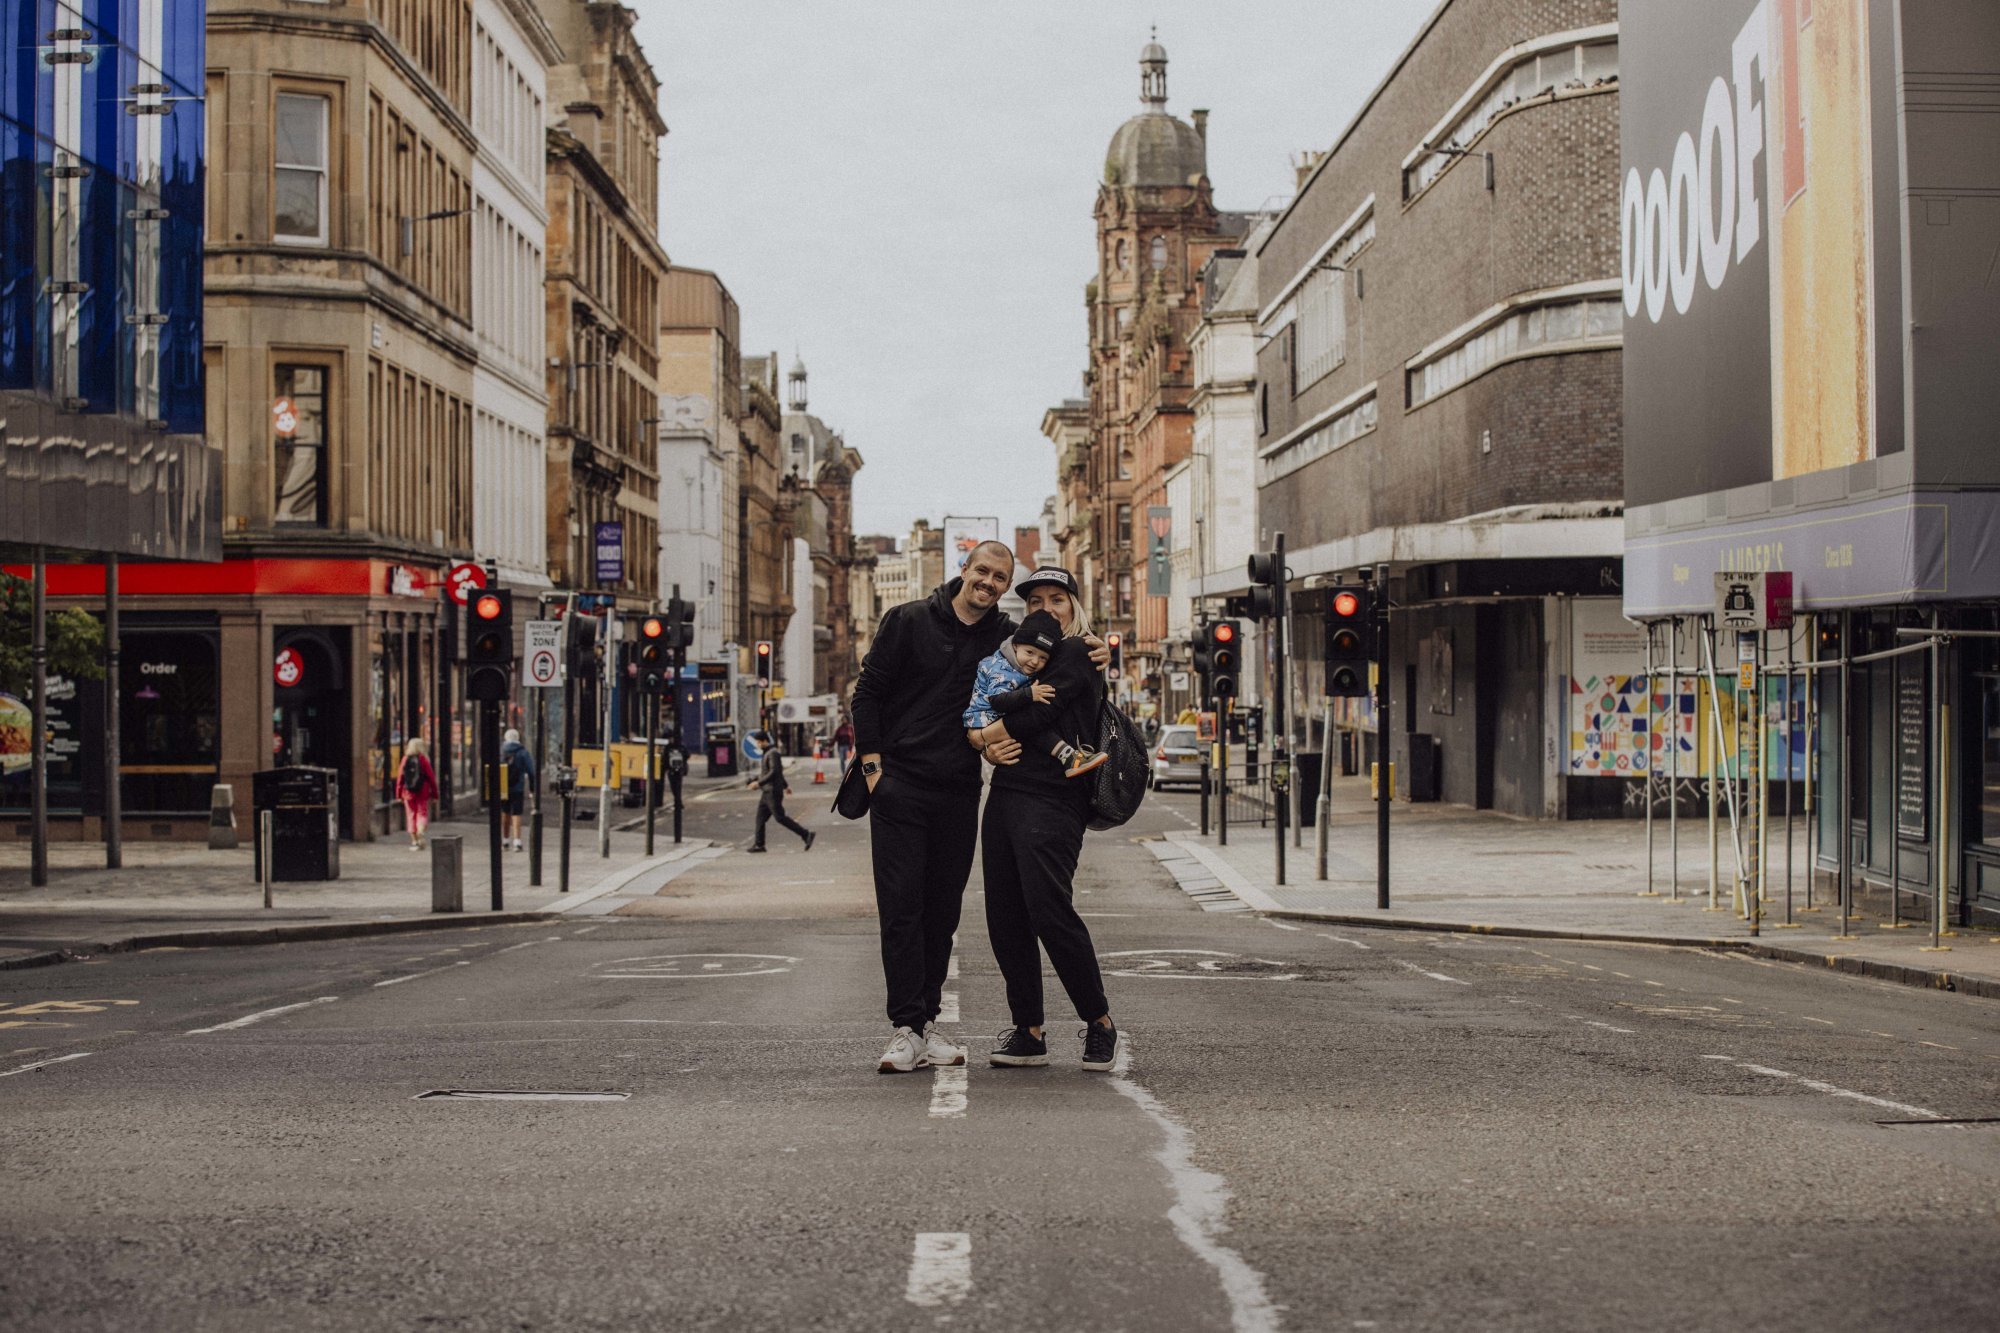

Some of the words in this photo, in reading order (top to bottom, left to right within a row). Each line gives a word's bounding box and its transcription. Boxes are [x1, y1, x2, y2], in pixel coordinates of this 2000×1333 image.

[1723, 573, 1734, 581] 24
[1738, 573, 1754, 581] HRS
[1731, 619, 1749, 627] TAXI
[533, 637, 556, 647] ZONE
[140, 662, 178, 675] Order
